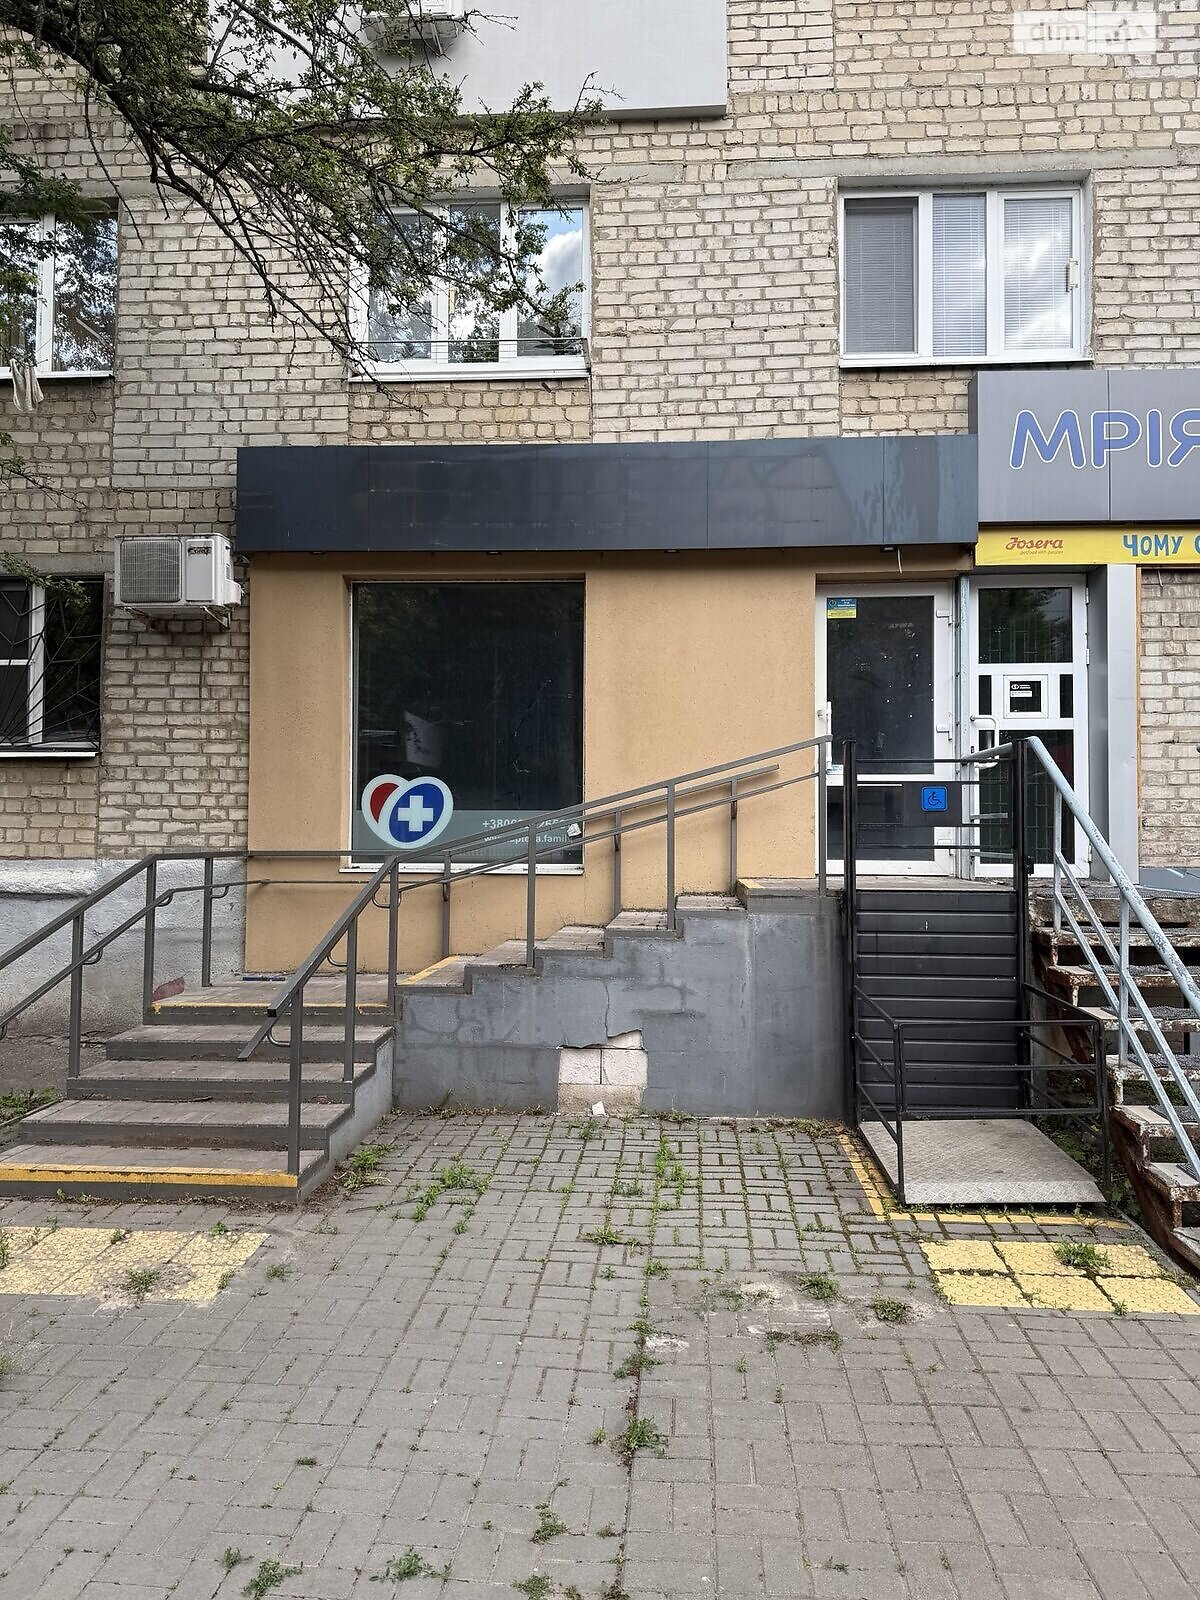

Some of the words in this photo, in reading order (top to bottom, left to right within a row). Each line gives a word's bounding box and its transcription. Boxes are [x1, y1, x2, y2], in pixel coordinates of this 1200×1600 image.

[1009, 408, 1200, 469] МРІЯ
[1005, 537, 1064, 550] Josera
[1123, 533, 1183, 557] ЧОМУ
